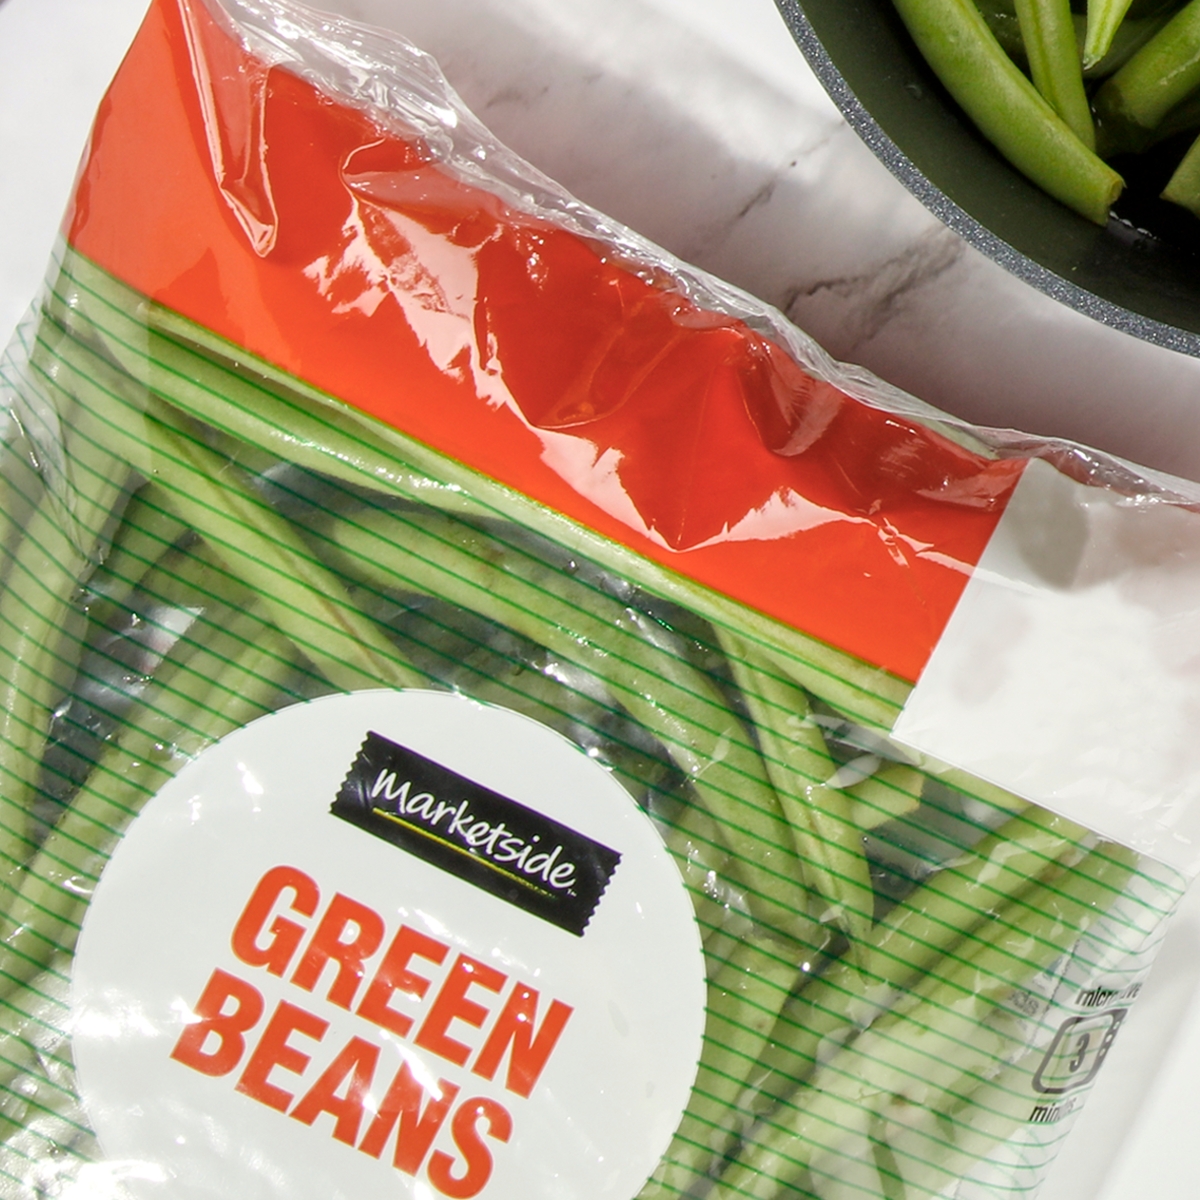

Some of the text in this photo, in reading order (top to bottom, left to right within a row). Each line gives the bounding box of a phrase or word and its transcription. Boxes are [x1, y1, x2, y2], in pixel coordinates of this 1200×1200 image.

[371, 767, 576, 889] Marketside
[232, 865, 573, 1099] GREEN
[1068, 1033, 1090, 1072] 3
[170, 968, 513, 1199] BEANS
